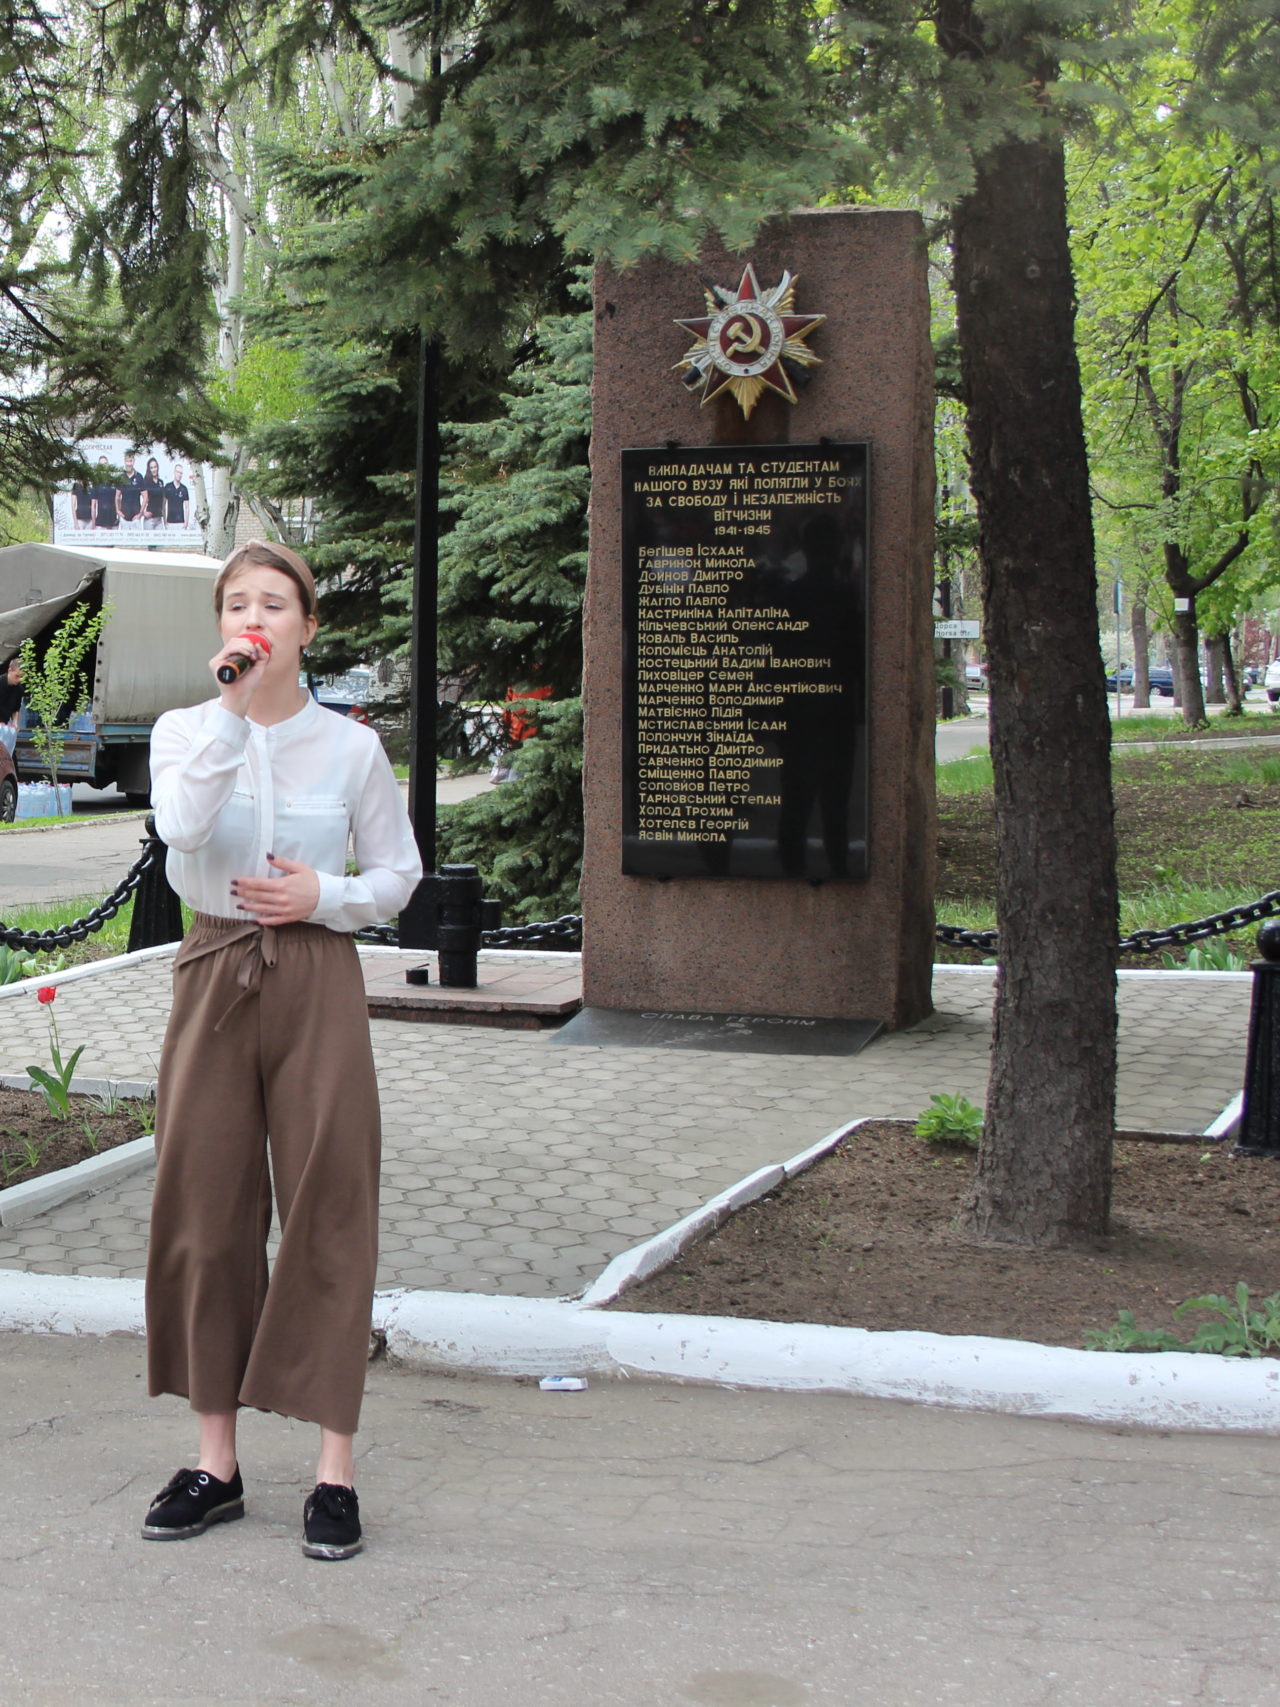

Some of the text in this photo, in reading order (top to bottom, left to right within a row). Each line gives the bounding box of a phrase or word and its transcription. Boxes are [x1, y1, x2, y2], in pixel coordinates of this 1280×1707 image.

[738, 463, 755, 474] ТА
[761, 461, 840, 473] СТУДЕНТАМ
[634, 476, 862, 491] НАШОГО ВУЗУ ЯКІ ПОЛЯГЛИ У БОЯХ
[646, 497, 663, 507] ЗА
[668, 495, 728, 507] СВОБОДУ
[743, 491, 841, 505] НЕЗАЛЕЖНІСТЬ
[714, 510, 772, 521] ВІТЧИЗНИ
[714, 526, 771, 535] 1941-1945
[641, 1012, 816, 1026] СЛАВА ГЕРОЯМ
